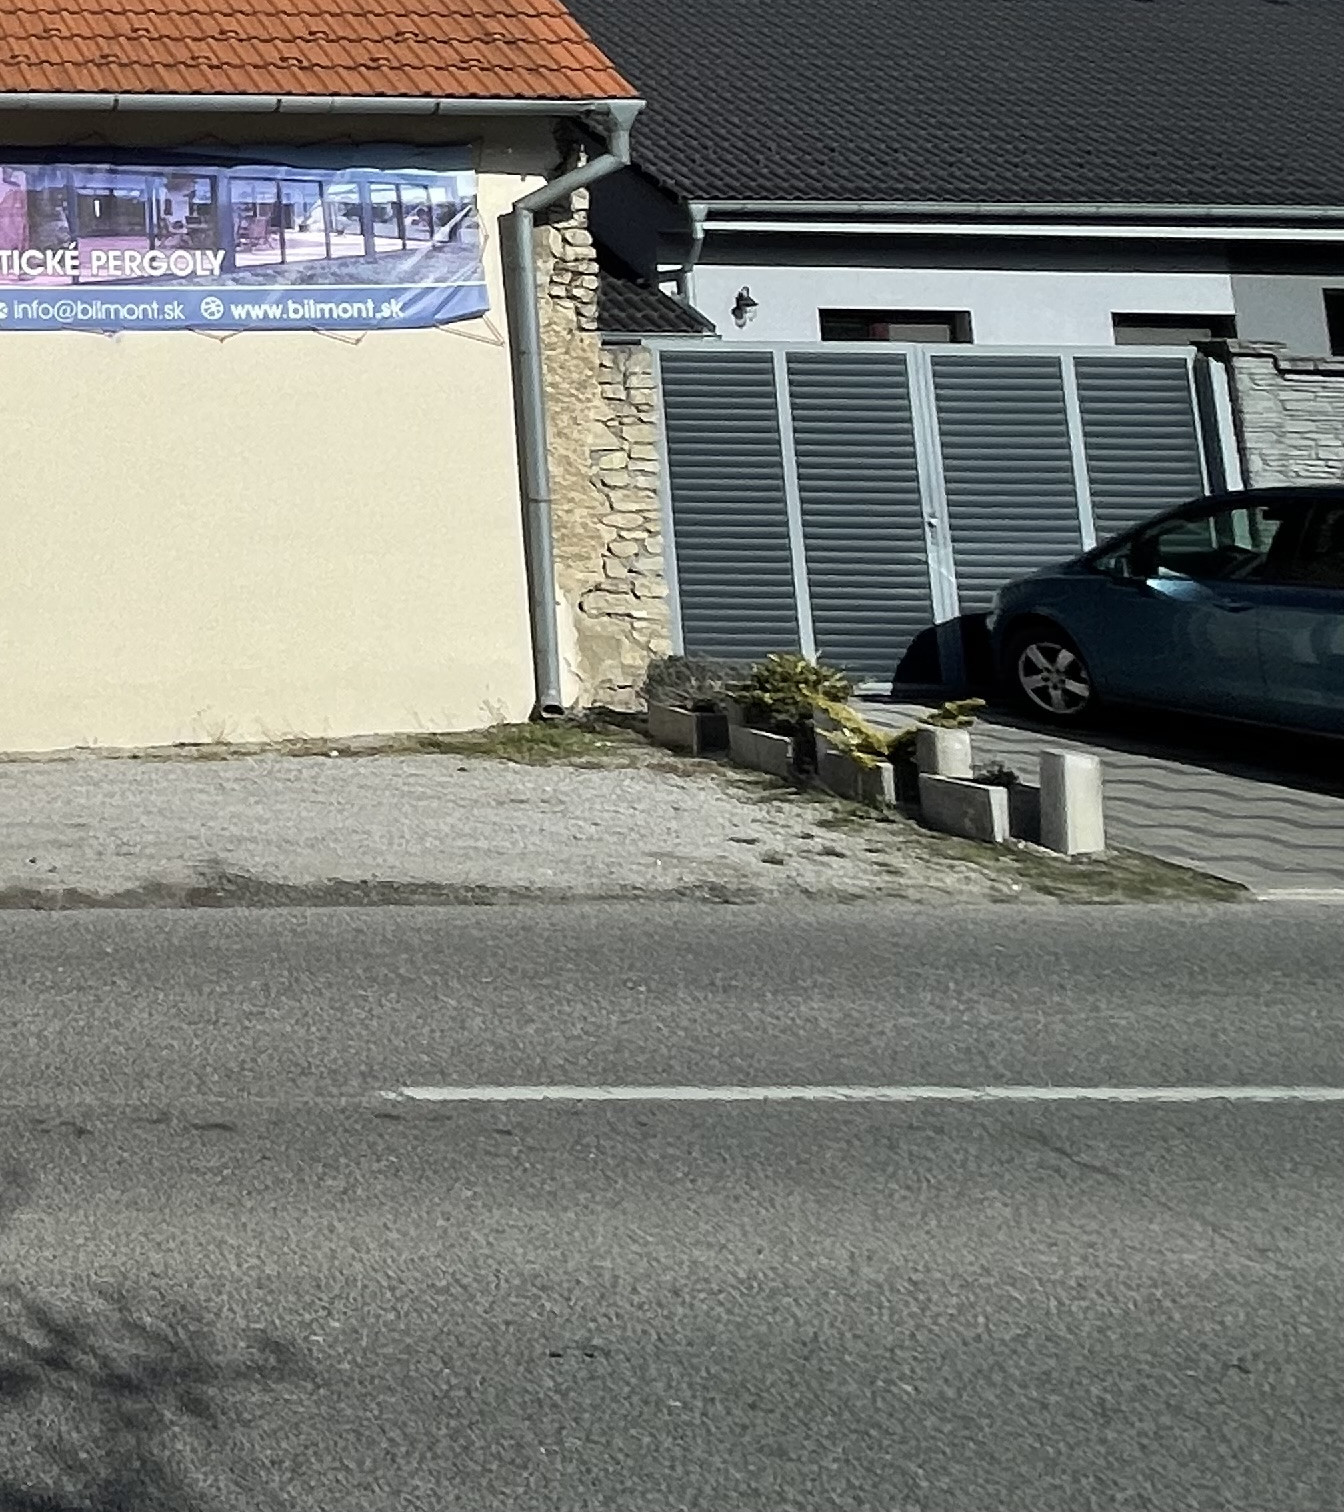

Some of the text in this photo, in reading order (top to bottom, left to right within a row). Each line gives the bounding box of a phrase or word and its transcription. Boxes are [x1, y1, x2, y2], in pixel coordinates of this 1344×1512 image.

[91, 250, 226, 276] PERGOLY
[14, 299, 186, 323] info@bilmont.sk
[230, 299, 405, 320] www.bilmont.sk
